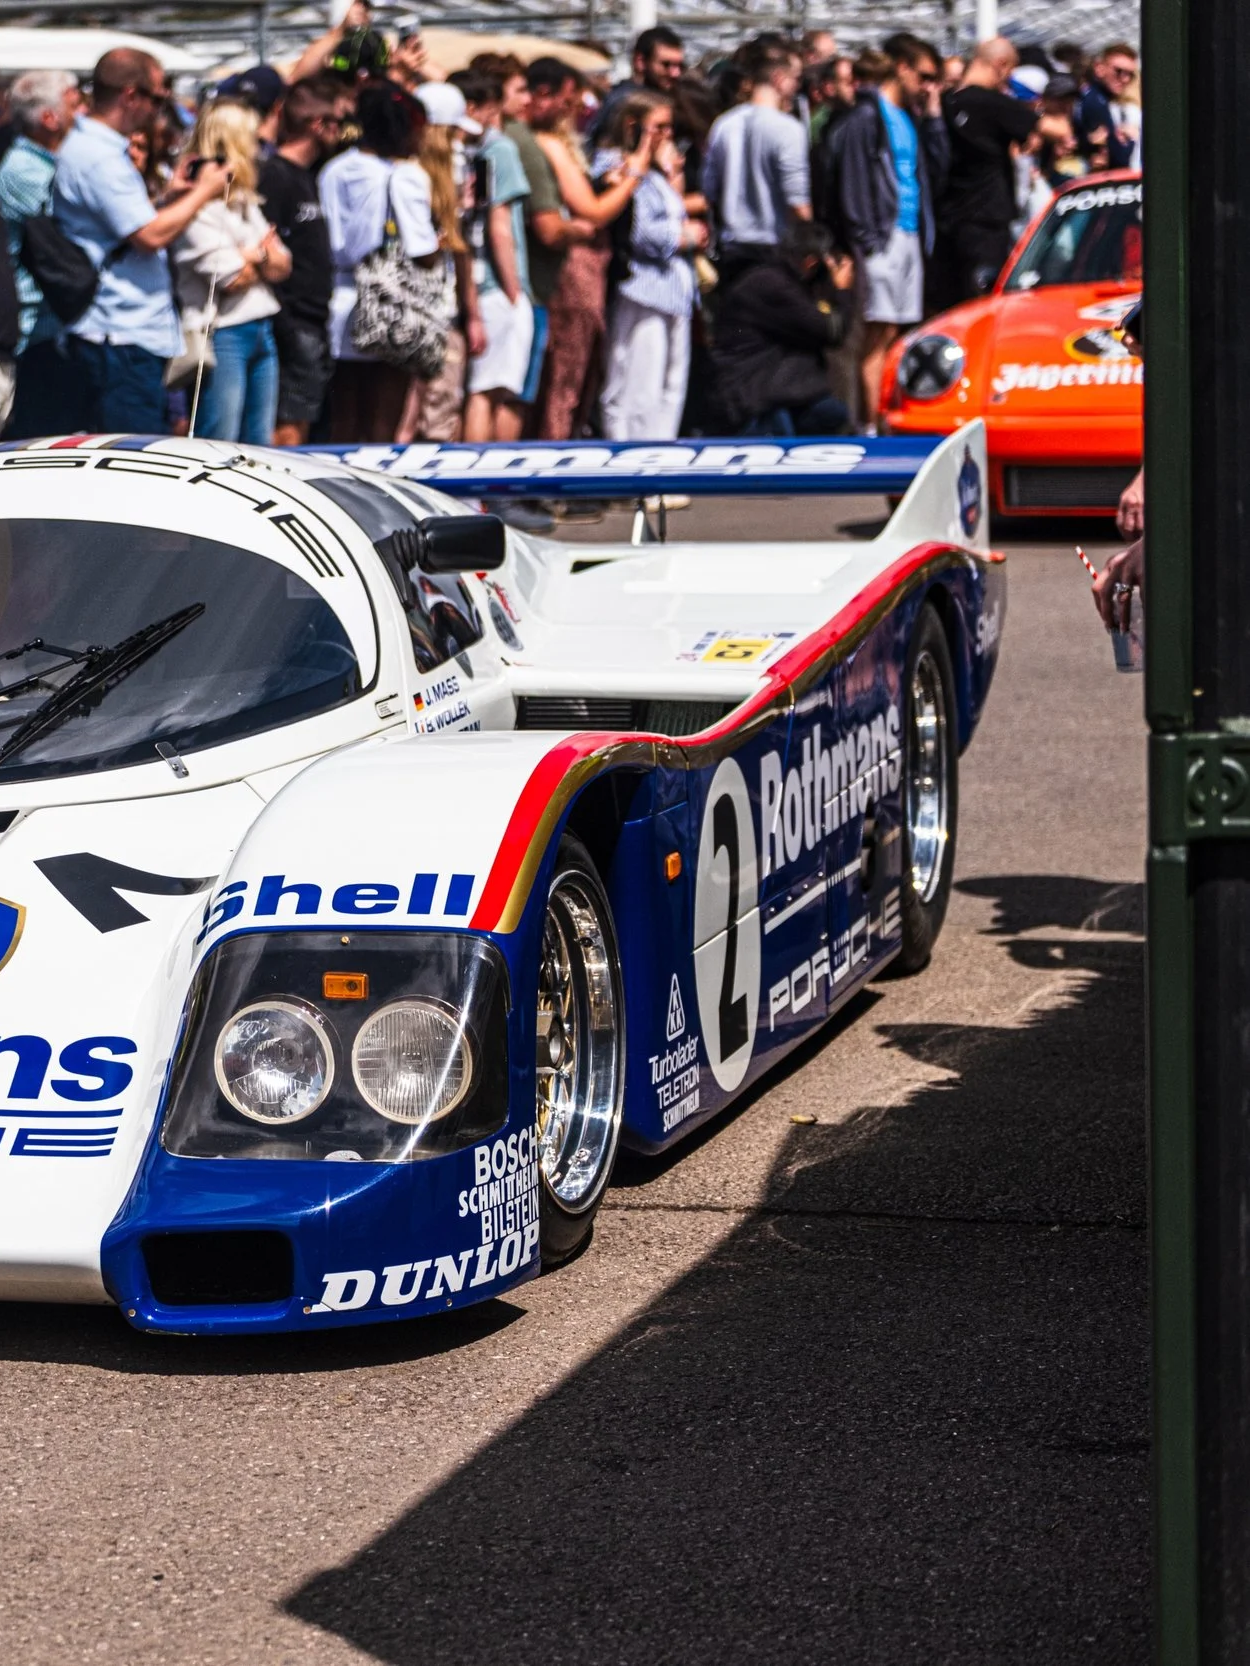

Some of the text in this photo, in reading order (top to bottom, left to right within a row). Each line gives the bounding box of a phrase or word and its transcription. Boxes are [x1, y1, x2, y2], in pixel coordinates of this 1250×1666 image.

[432, 676, 460, 700] MASS
[759, 704, 901, 880] Rothmans
[196, 873, 475, 946] Shell
[713, 792, 748, 1064] 2
[649, 1034, 699, 1086] Turbolader
[657, 1062, 700, 1110] TELETRON
[474, 1122, 539, 1187] BOSCH
[481, 1185, 540, 1245] BILSTEIN
[310, 1219, 540, 1314] DUNLOP
